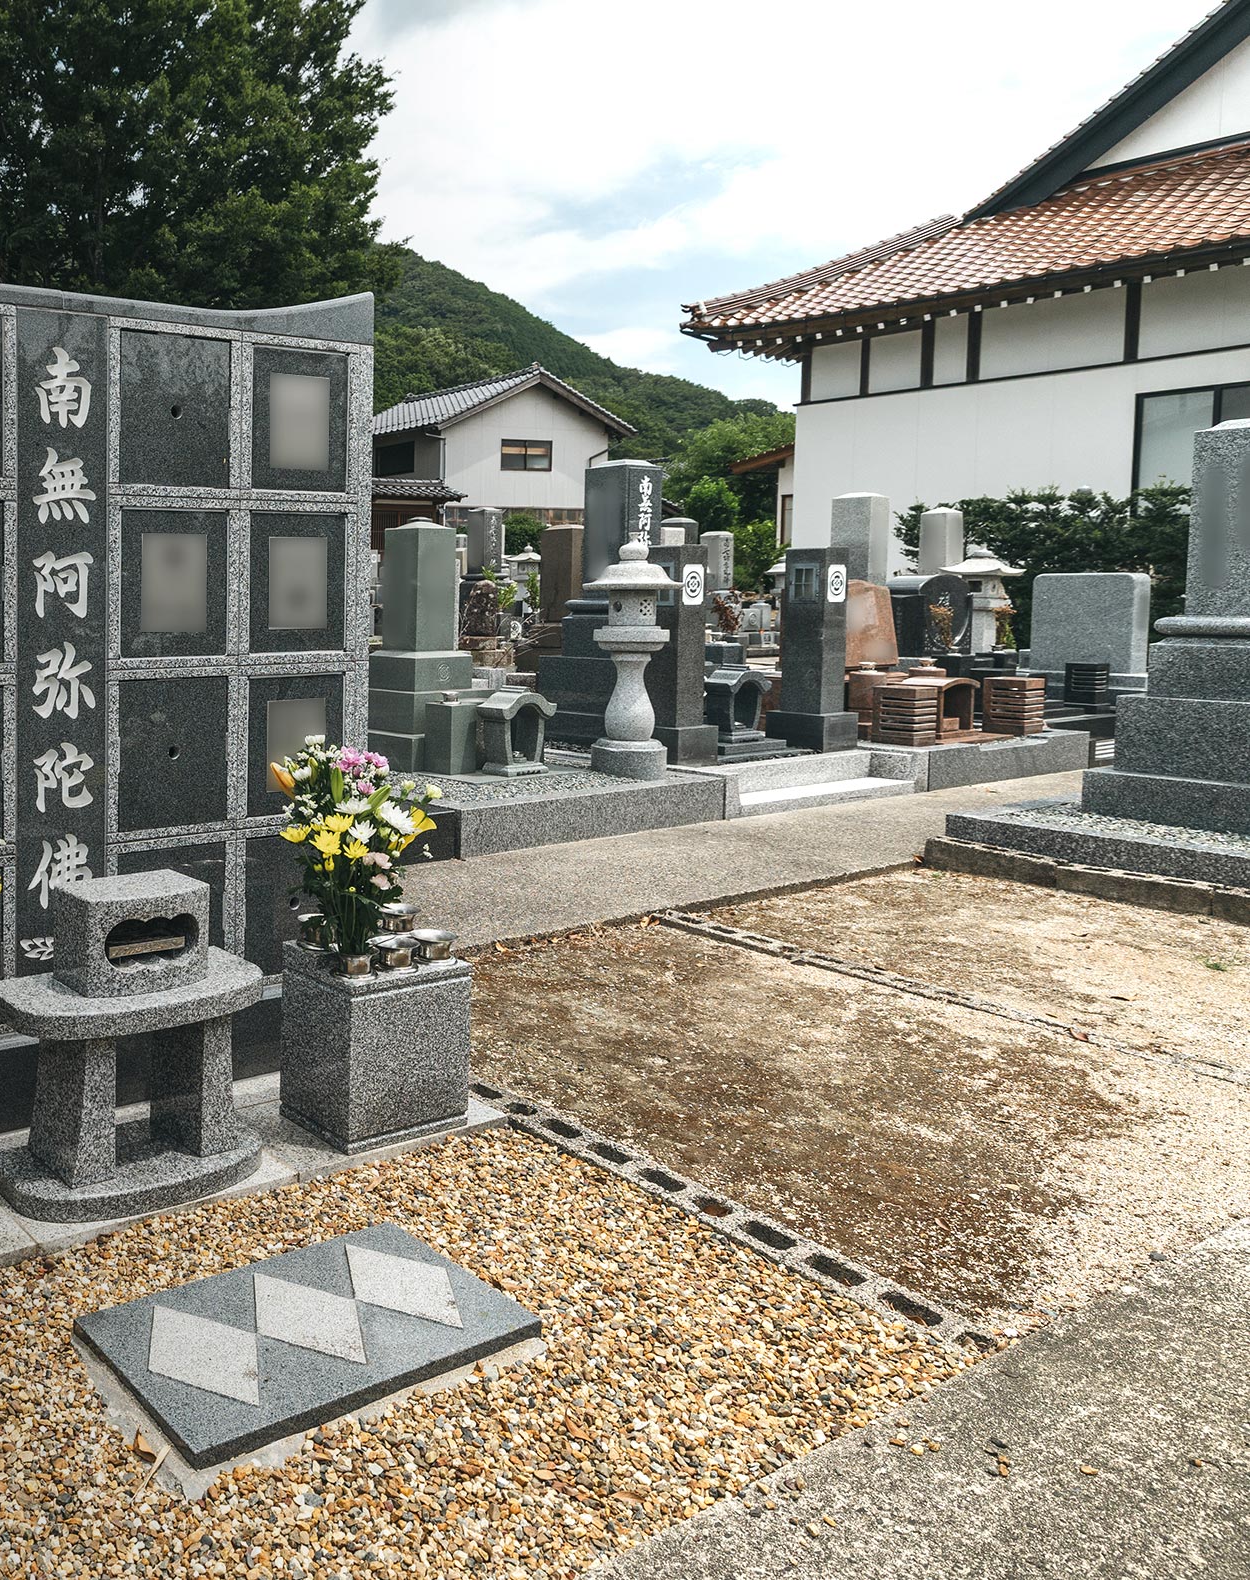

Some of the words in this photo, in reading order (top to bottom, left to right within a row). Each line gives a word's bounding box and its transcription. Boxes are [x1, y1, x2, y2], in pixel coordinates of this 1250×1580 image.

[28, 347, 96, 909] 南無阿弥陀佛
